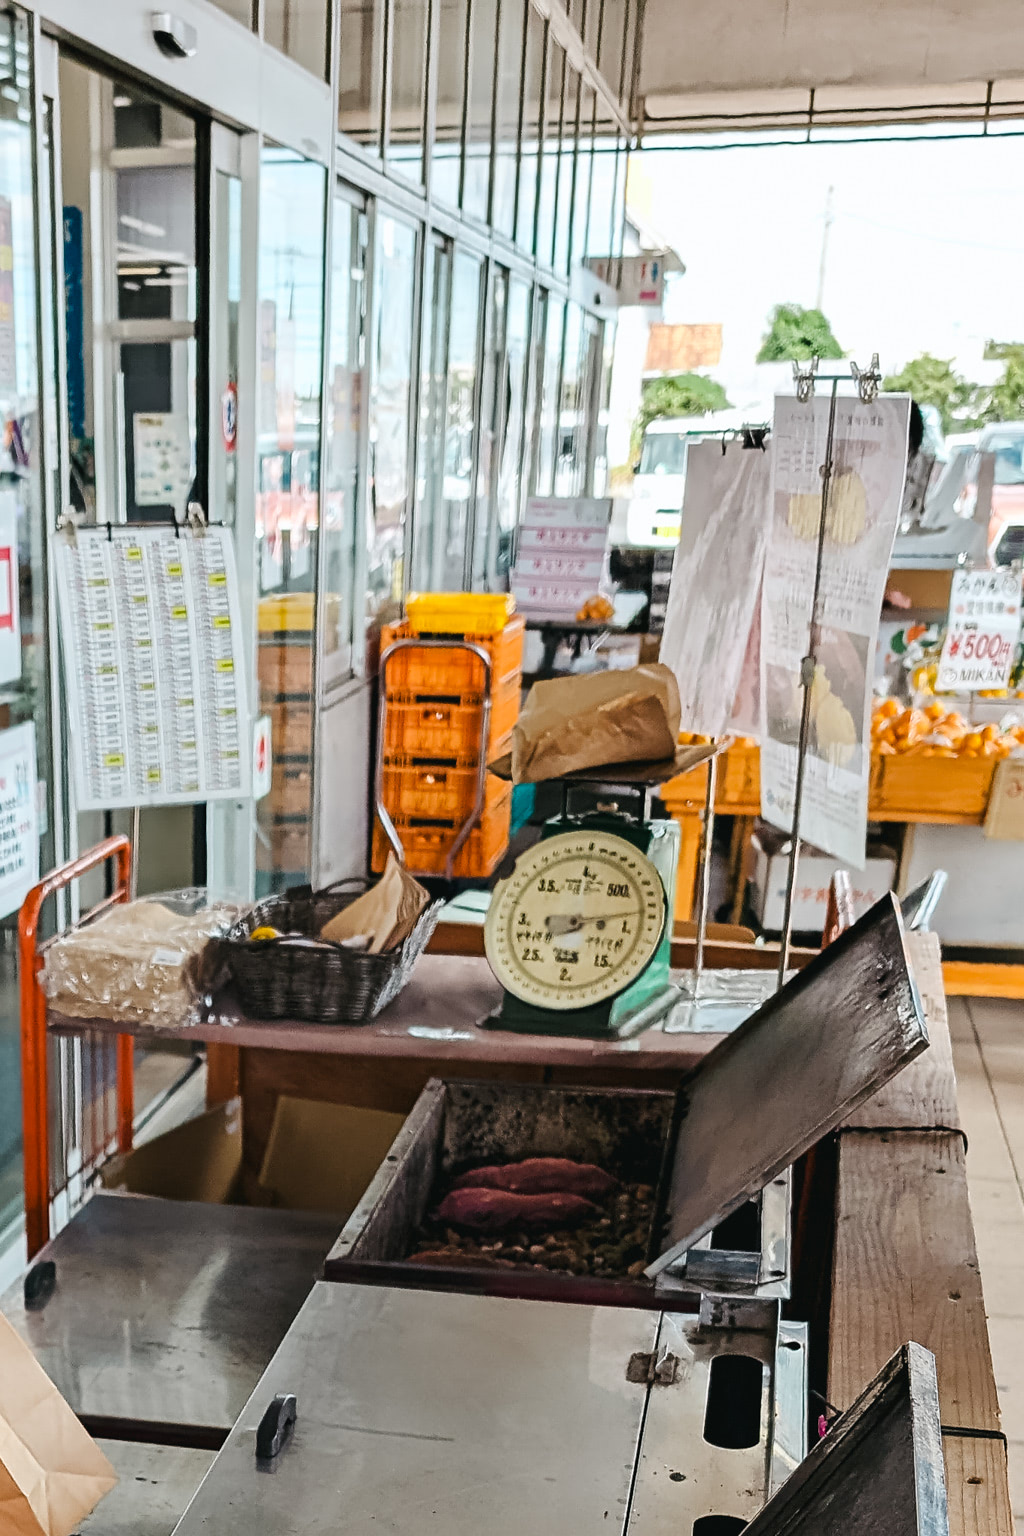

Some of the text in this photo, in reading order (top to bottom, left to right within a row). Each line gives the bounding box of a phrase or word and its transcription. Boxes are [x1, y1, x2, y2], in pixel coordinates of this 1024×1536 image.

[957, 578, 1001, 597] みかん
[960, 669, 1006, 682] MIKAN
